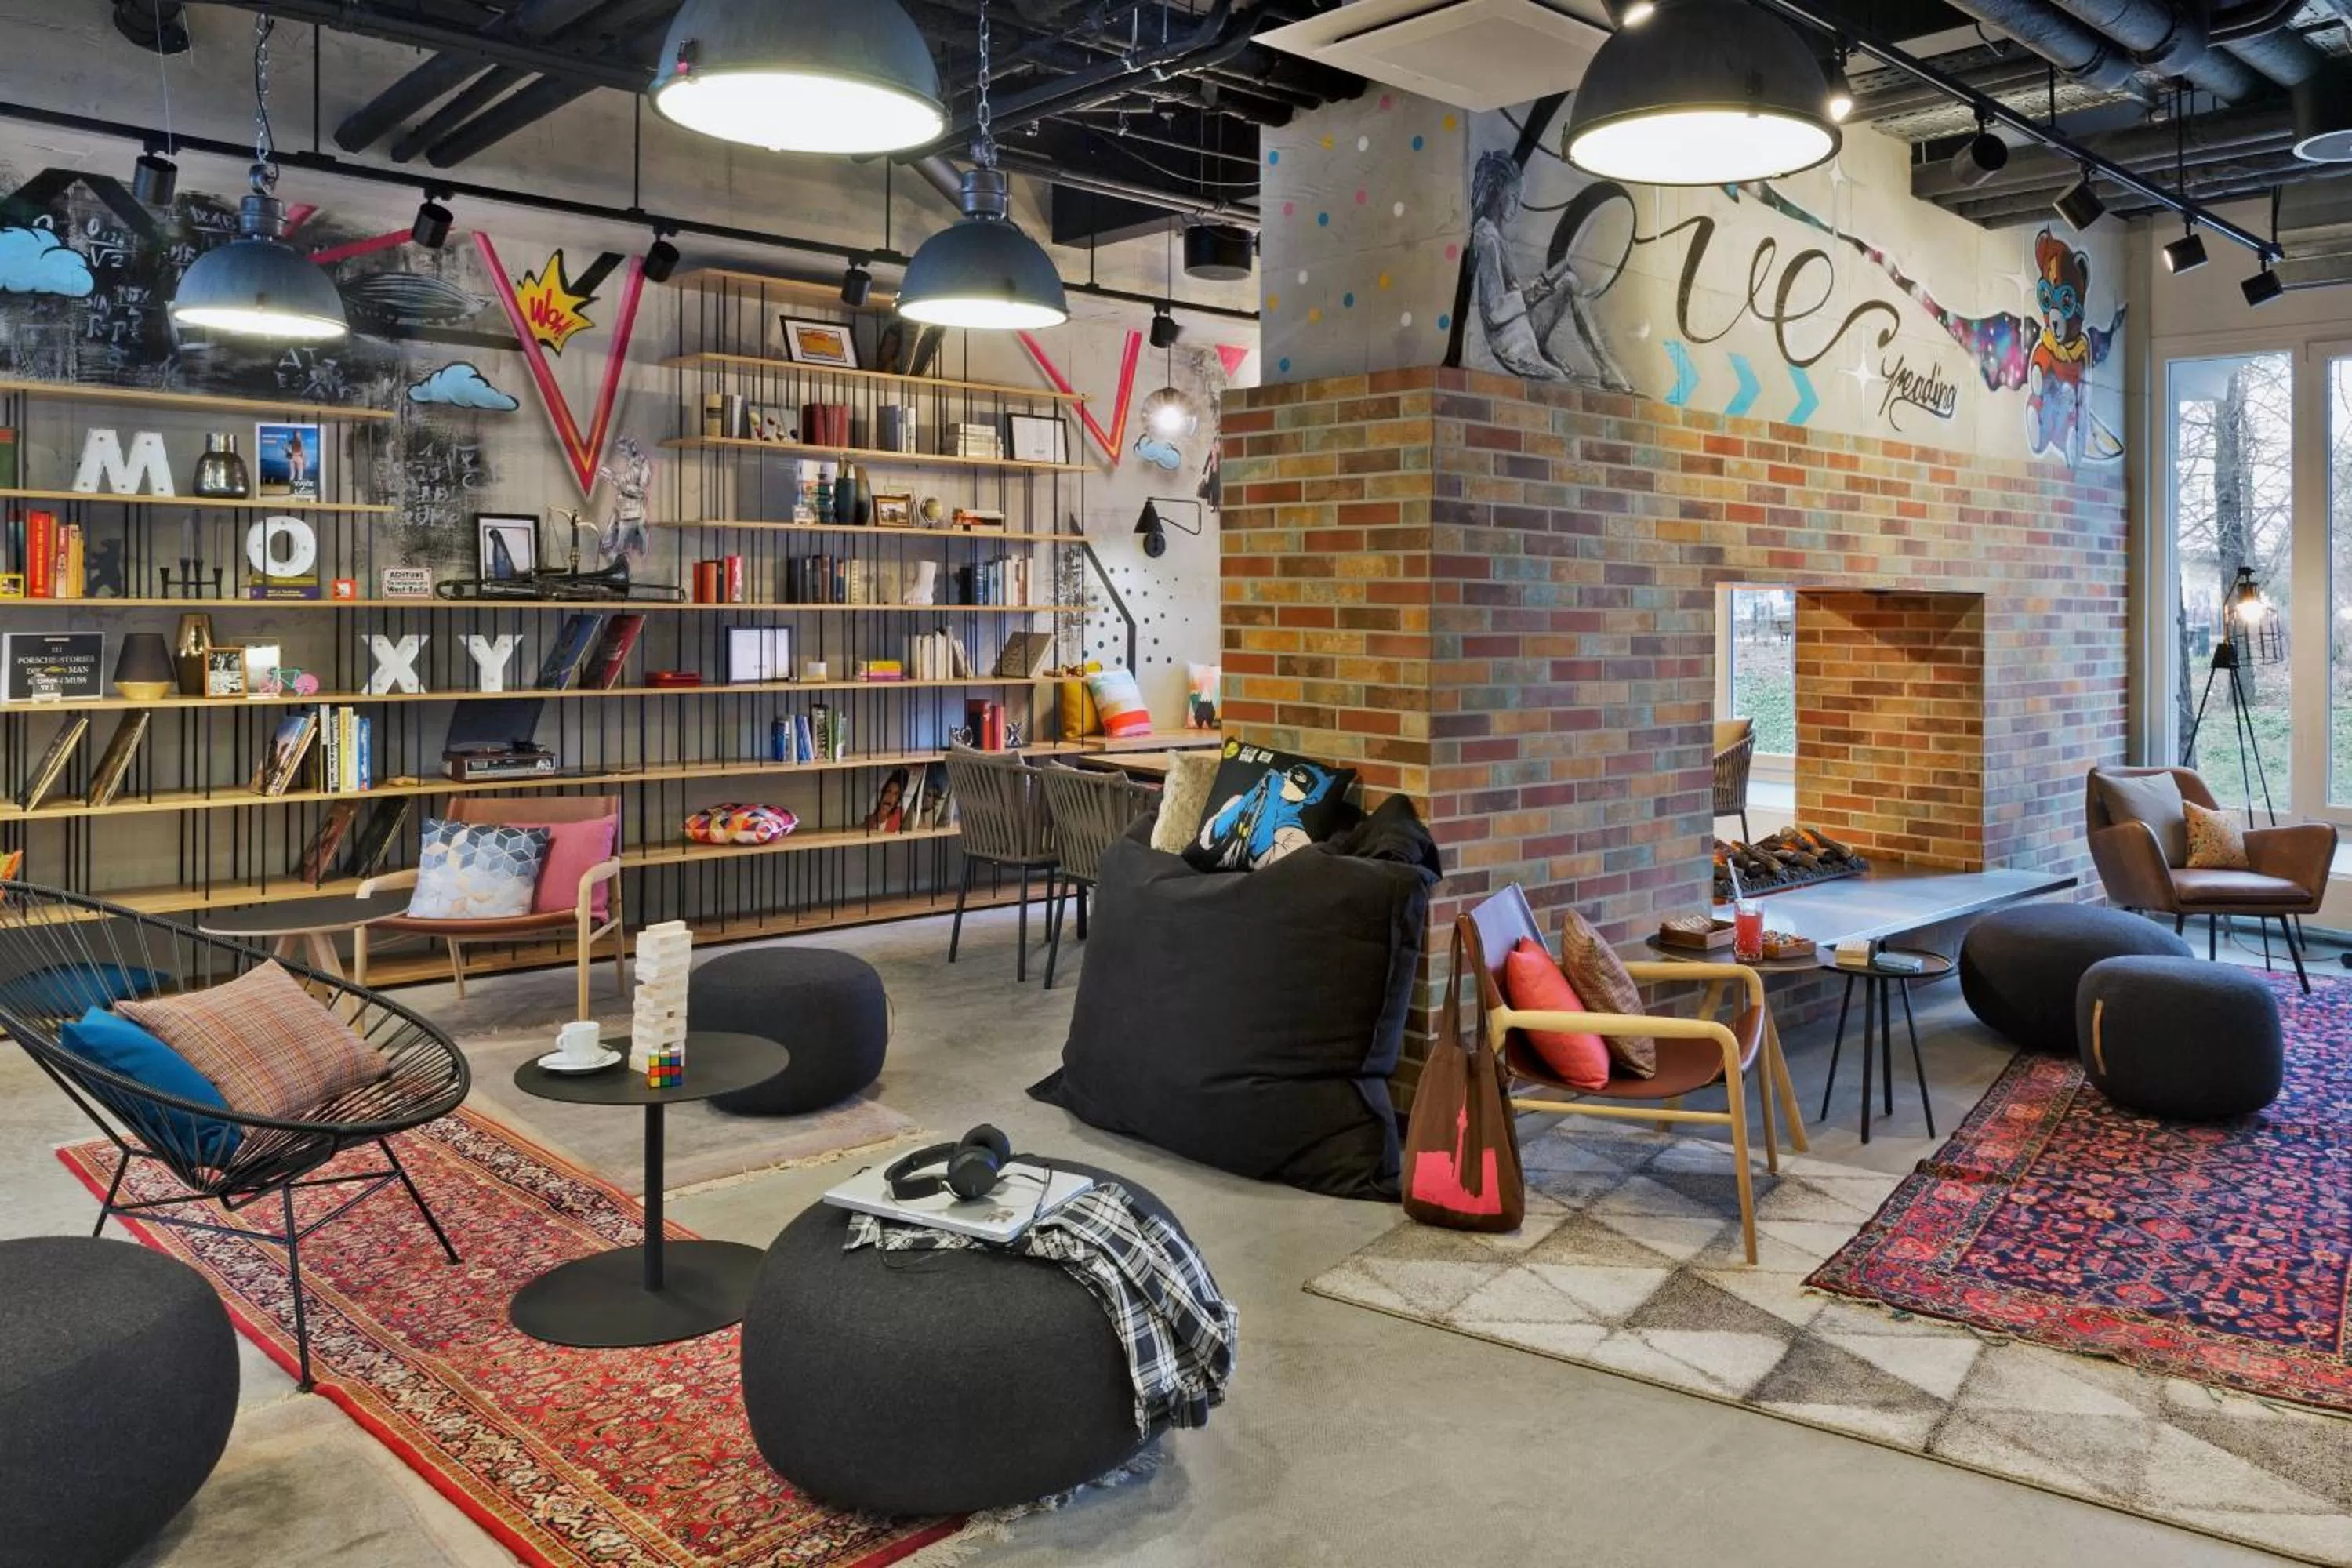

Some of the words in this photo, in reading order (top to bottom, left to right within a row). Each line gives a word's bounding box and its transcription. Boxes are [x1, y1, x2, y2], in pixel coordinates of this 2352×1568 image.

[1878, 354, 1958, 433] reading
[72, 428, 176, 497] M
[246, 515, 318, 578] O
[64, 676, 88, 684] MUSS
[361, 634, 430, 695] X
[458, 634, 524, 692] Y
